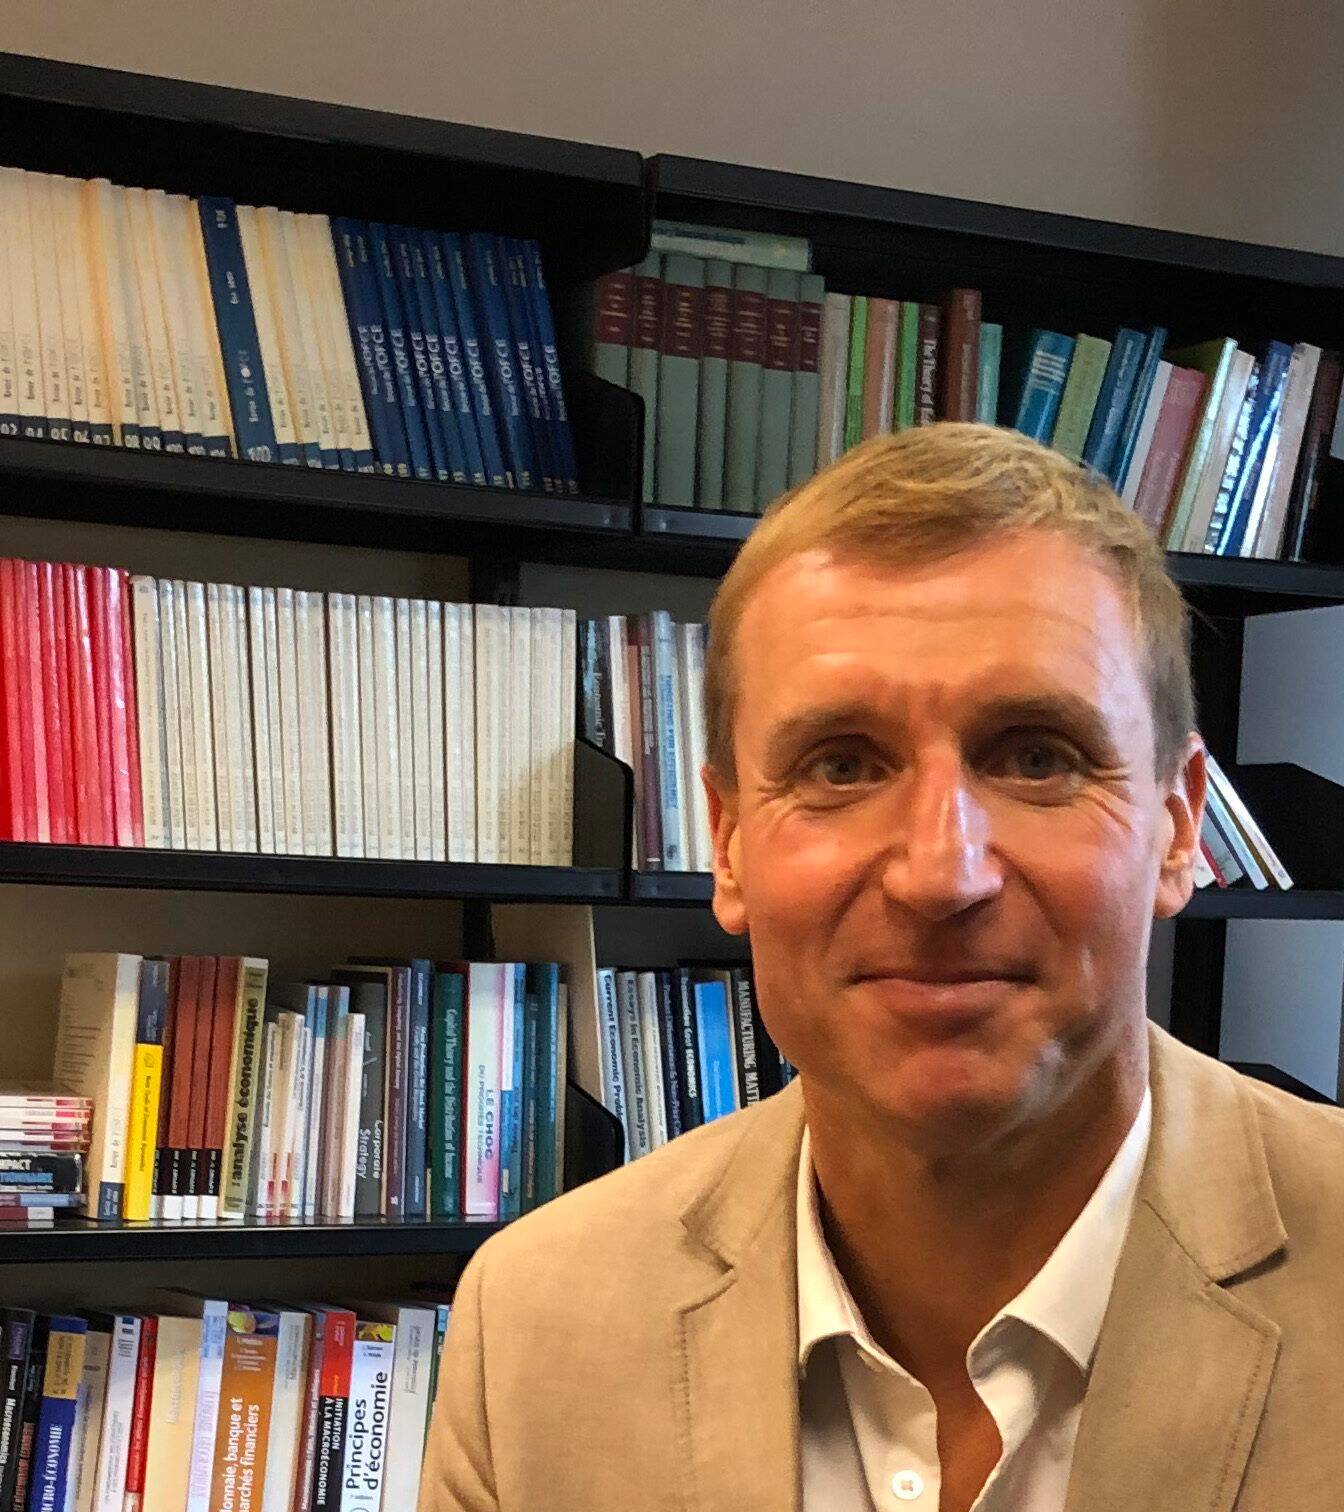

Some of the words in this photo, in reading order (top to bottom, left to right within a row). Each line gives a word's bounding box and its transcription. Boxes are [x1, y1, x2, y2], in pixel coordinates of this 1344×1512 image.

[604, 975, 615, 1022] Current
[626, 979, 636, 1021] Essays
[444, 1009, 456, 1038] Capital
[737, 981, 758, 1069] MANUFACTURING
[236, 997, 259, 1108] économique
[443, 1038, 456, 1065] Theory
[444, 1067, 454, 1080] and
[609, 1025, 620, 1083] Economic
[632, 1038, 642, 1094] Economic
[685, 1049, 697, 1098] ECONOMICS
[444, 1082, 456, 1094] the
[486, 1089, 495, 1106] LE
[444, 1142, 456, 1151] of
[485, 1111, 494, 1159] CHOC
[636, 1097, 647, 1148] Analysis
[356, 1128, 371, 1179] Strategy
[229, 1397, 243, 1412] et
[323, 1406, 332, 1419] LA
[331, 1398, 344, 1450] INITIATION
[221, 1414, 241, 1462] banque
[241, 1404, 260, 1465] financiers
[345, 1399, 367, 1490] Principes
[363, 1372, 389, 1490] d'économie
[316, 1421, 331, 1505] MACROÉCONOMIE
